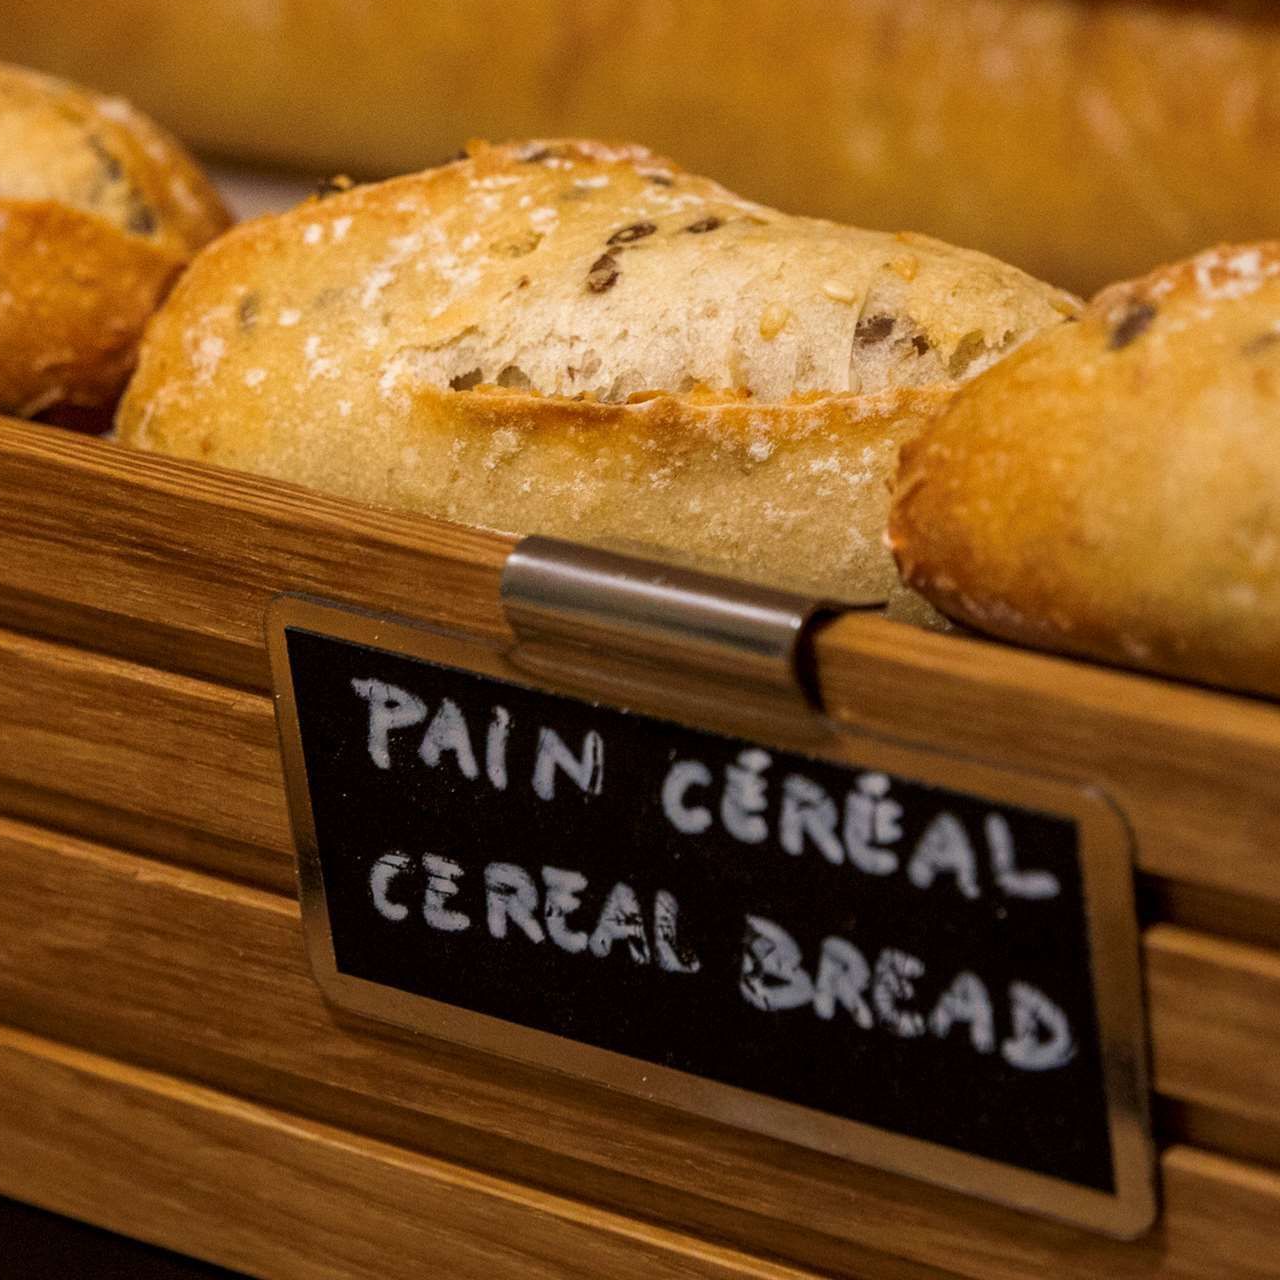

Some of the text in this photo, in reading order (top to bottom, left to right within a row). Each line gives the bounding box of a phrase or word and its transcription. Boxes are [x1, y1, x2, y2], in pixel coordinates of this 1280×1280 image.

[350, 676, 1060, 900] PAIN CÉRÉAL
[369, 851, 1076, 1072] CEREAL BREAD
